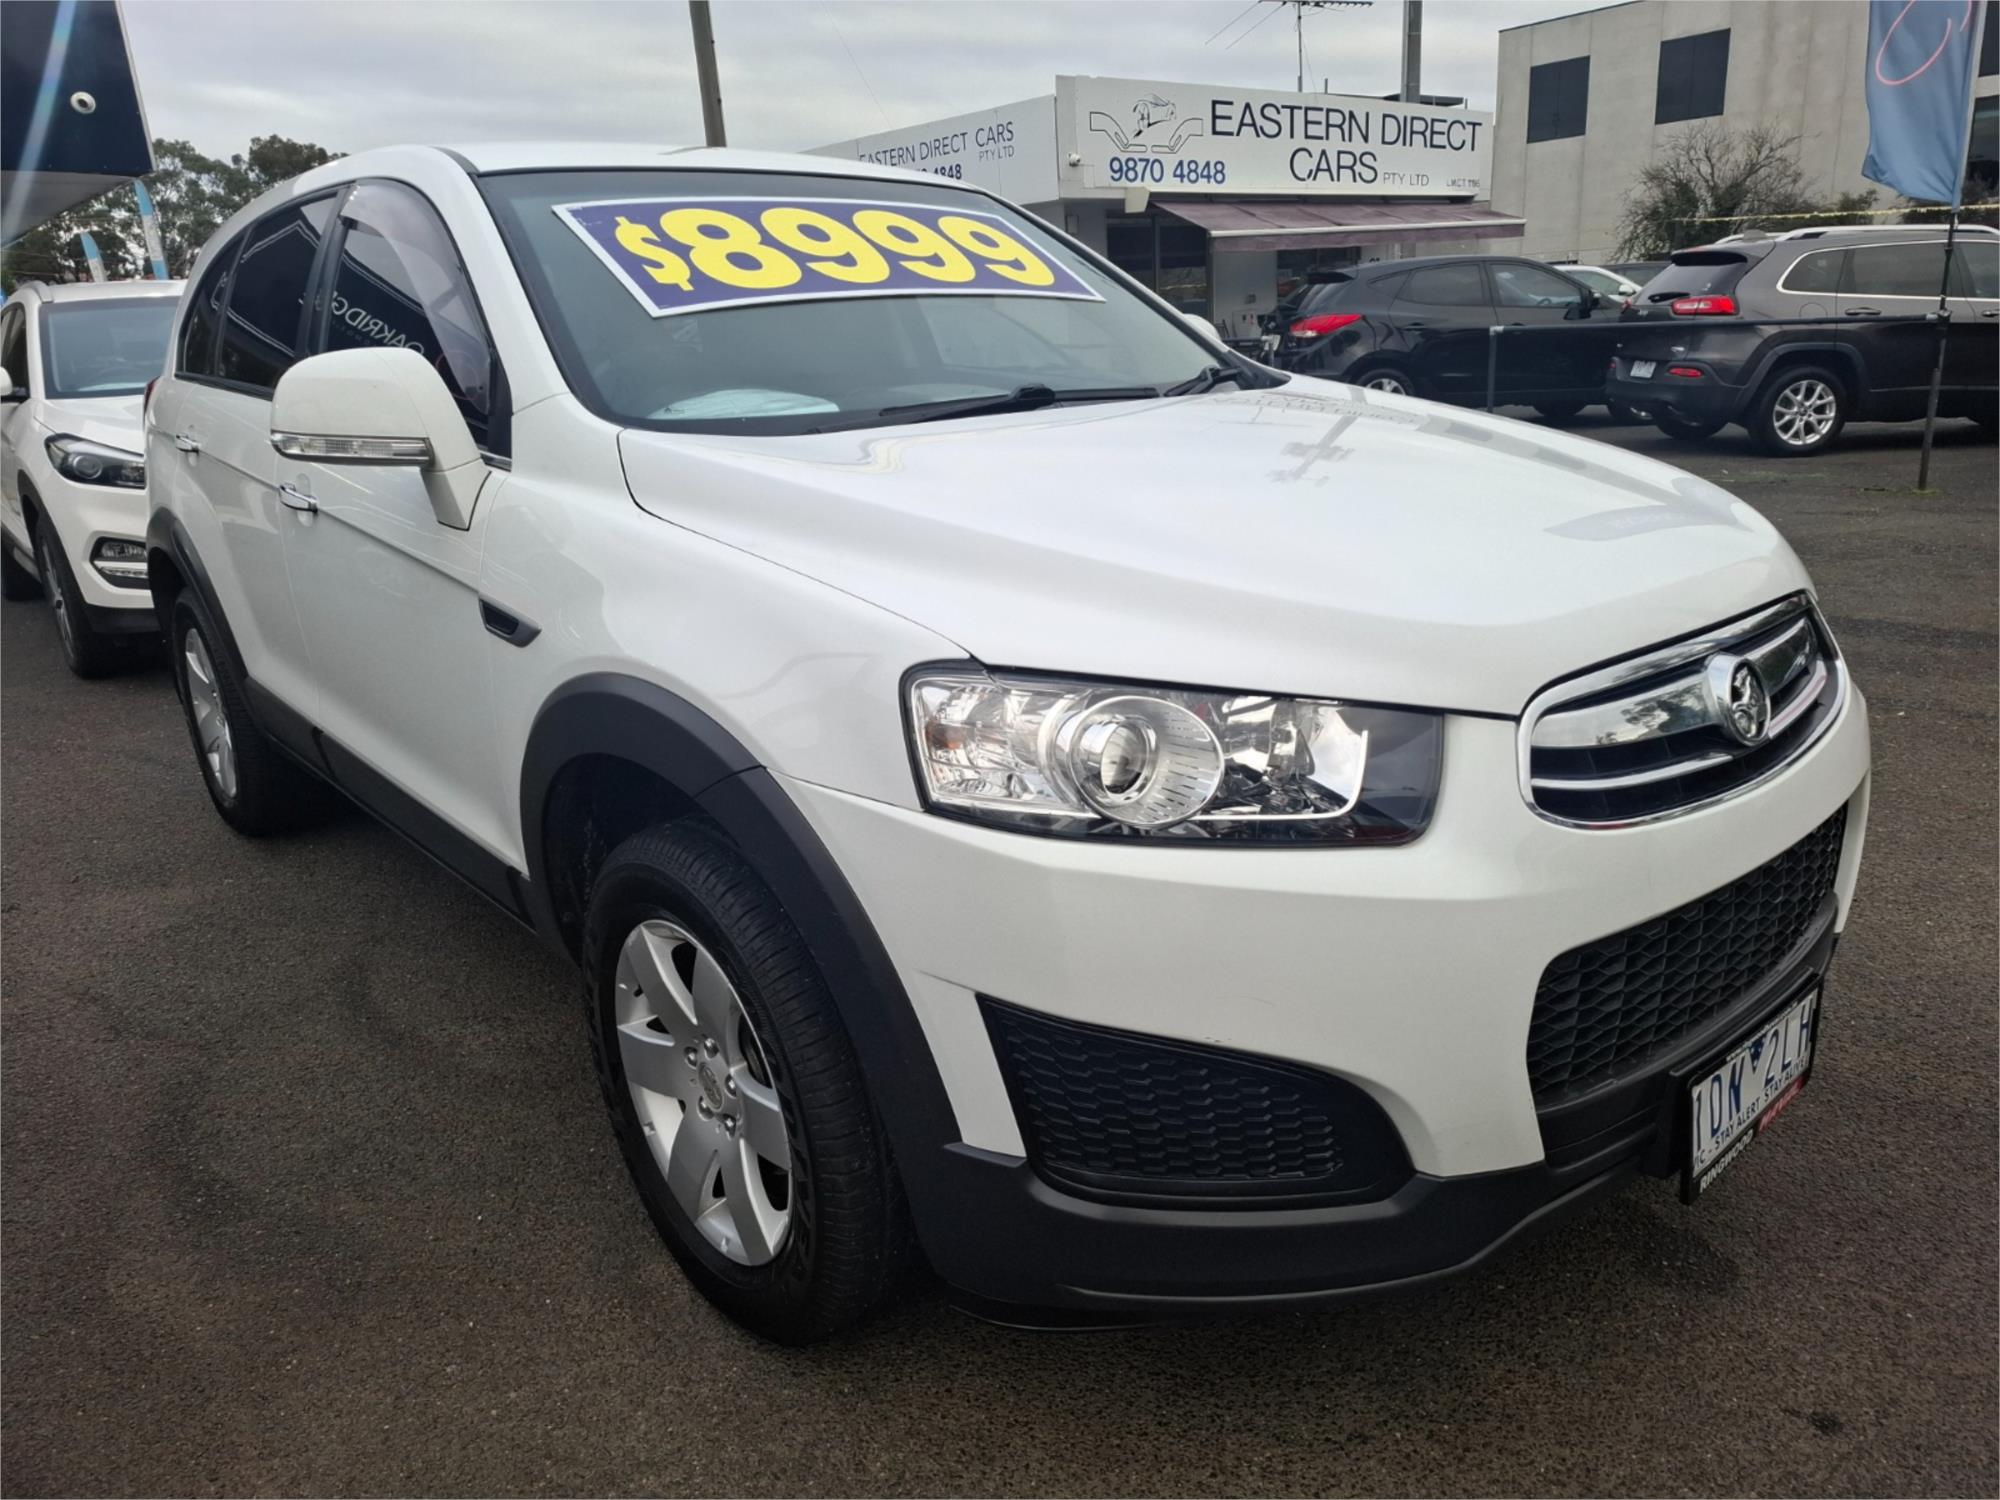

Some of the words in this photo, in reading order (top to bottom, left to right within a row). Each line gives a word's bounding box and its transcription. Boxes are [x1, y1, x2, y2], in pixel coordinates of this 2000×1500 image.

[920, 132, 968, 160] DIRECT
[975, 121, 1014, 147] CARS
[1211, 100, 1369, 143] EASTERN
[1381, 113, 1482, 151] DIRECT
[979, 150, 996, 162] PTY
[997, 145, 1014, 159] LTD
[1109, 157, 1164, 182] 9870
[1172, 159, 1226, 184] 4848
[1290, 147, 1378, 184] CARS
[1383, 171, 1405, 186] PTY
[1409, 173, 1429, 187] LTD
[614, 207, 1055, 291] $8999
[1715, 1123, 1733, 1150] STAY
[1736, 1097, 1760, 1129] ALERT
[1764, 1078, 1782, 1102] STAY
[1700, 1129, 1753, 1193] RINGWOOD
